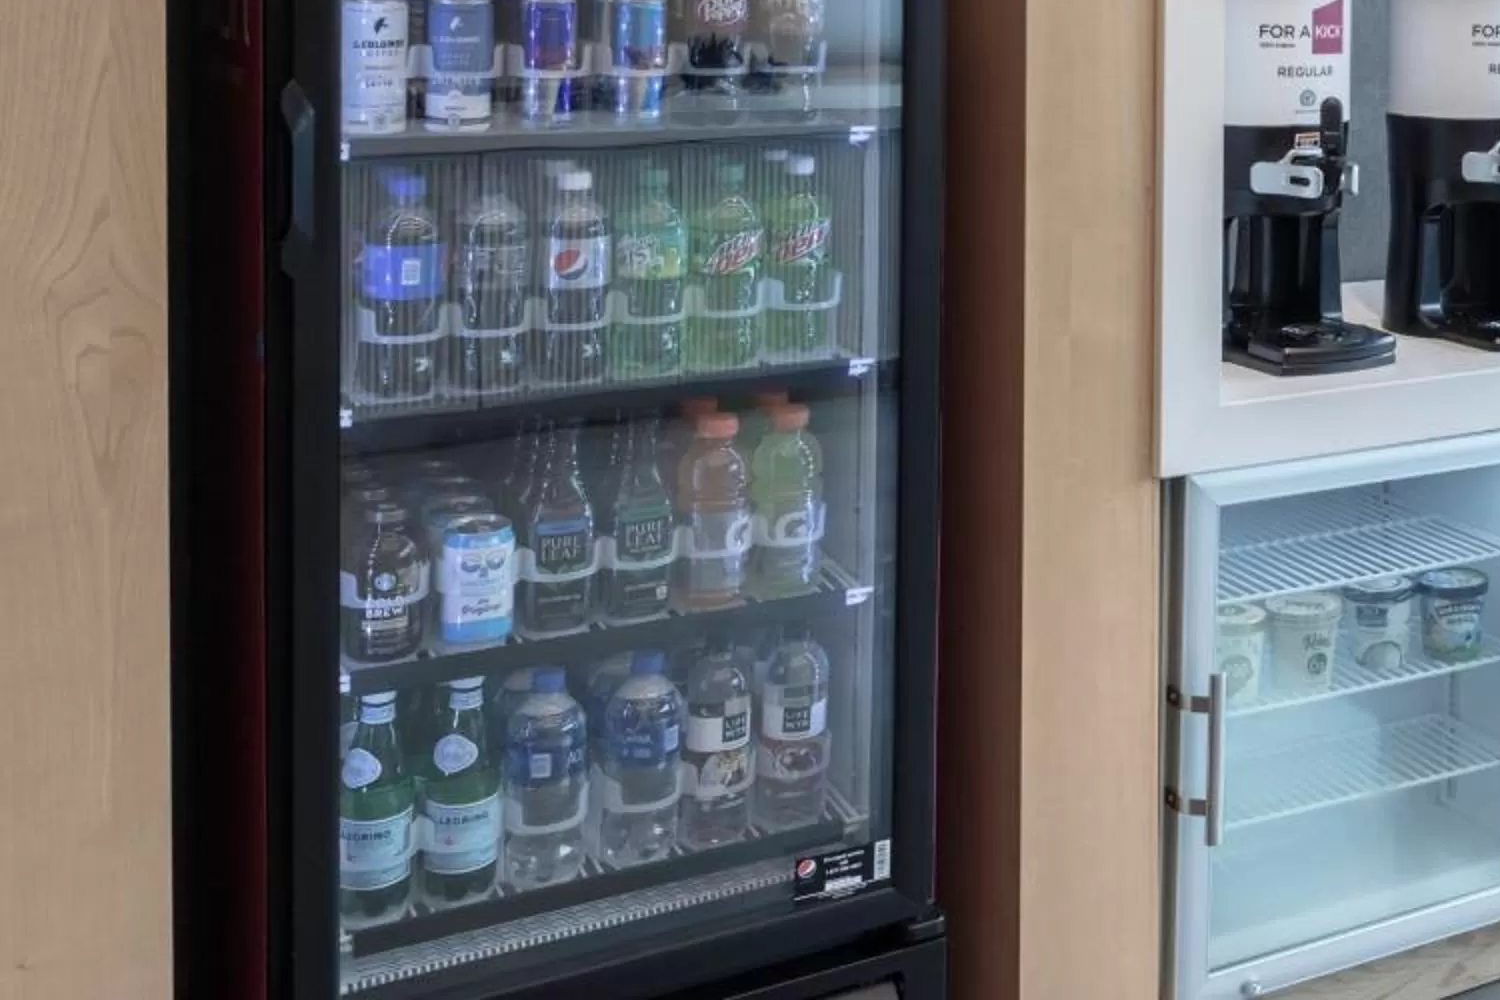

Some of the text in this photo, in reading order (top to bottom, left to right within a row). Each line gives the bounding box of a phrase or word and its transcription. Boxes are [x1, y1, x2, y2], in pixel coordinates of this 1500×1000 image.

[1258, 24, 1296, 39] FOR
[1301, 25, 1311, 38] A
[1277, 65, 1333, 78] REGULAR
